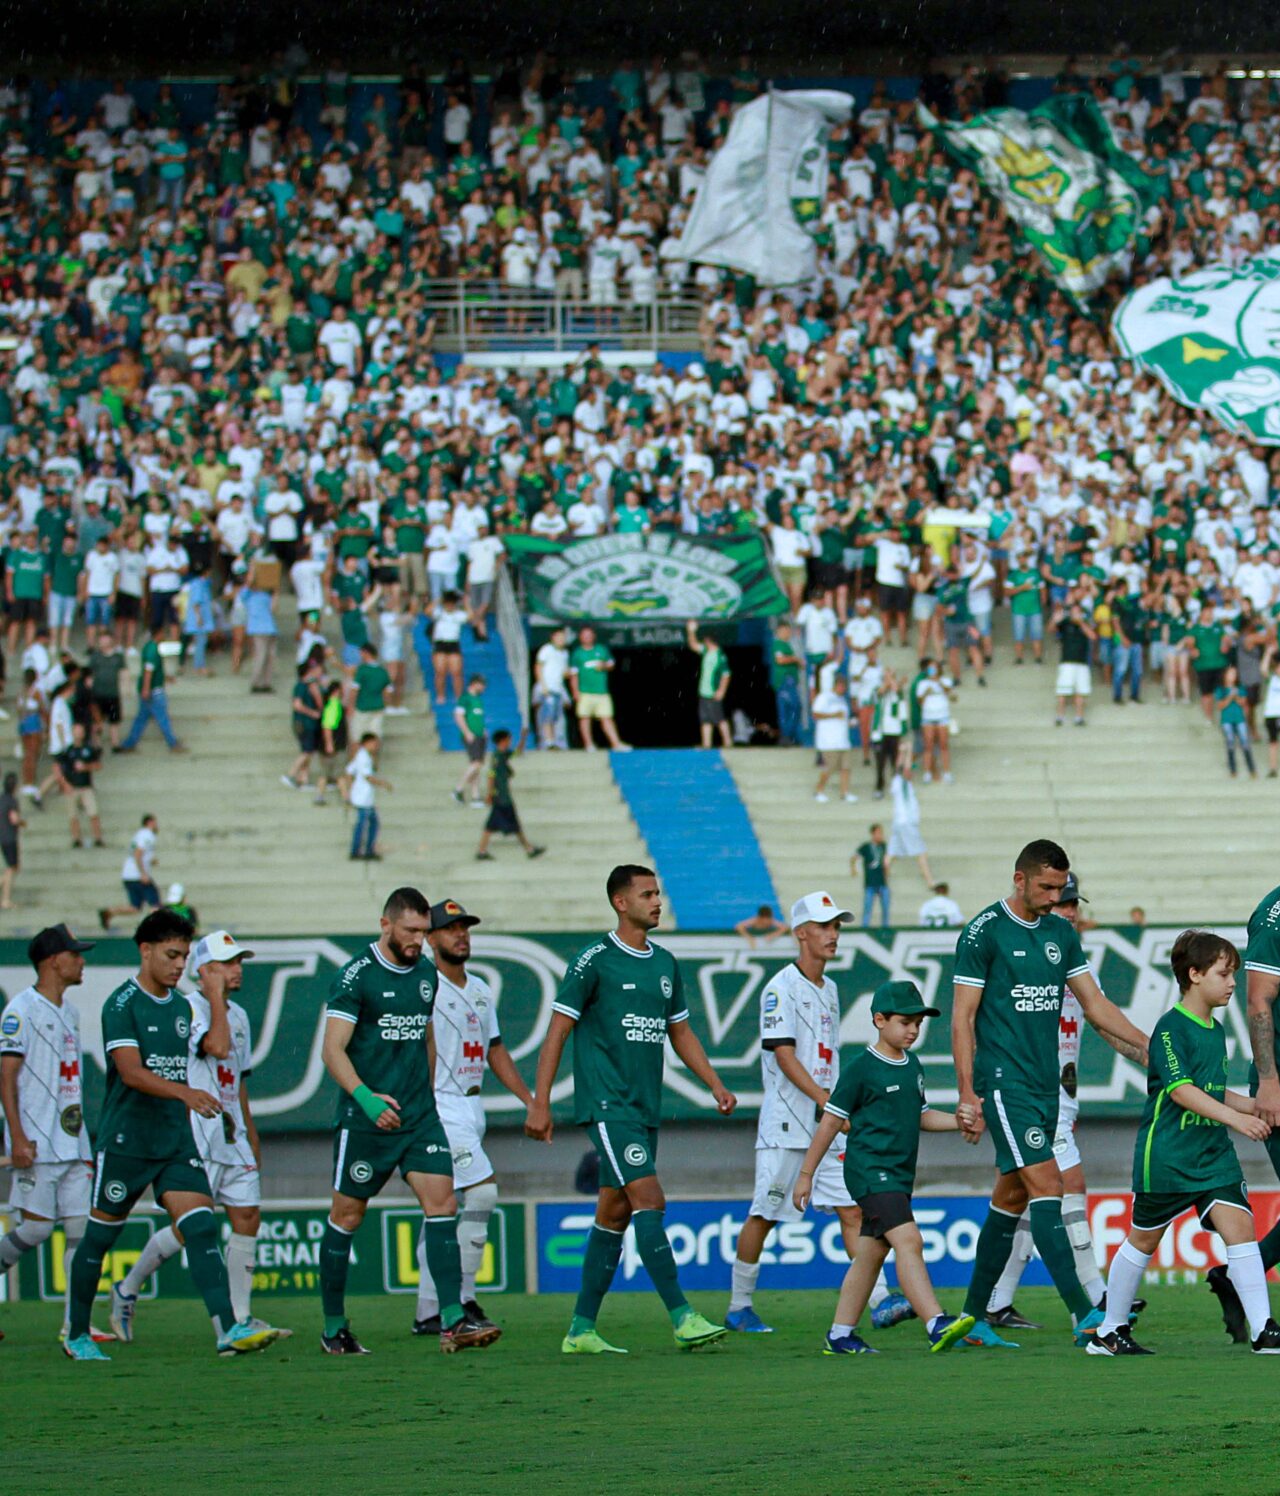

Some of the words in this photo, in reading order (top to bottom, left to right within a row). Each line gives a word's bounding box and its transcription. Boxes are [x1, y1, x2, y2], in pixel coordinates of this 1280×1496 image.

[968, 910, 998, 940] HEBRON
[573, 943, 607, 972] HEBRON
[1161, 1031, 1180, 1076] HEBRON
